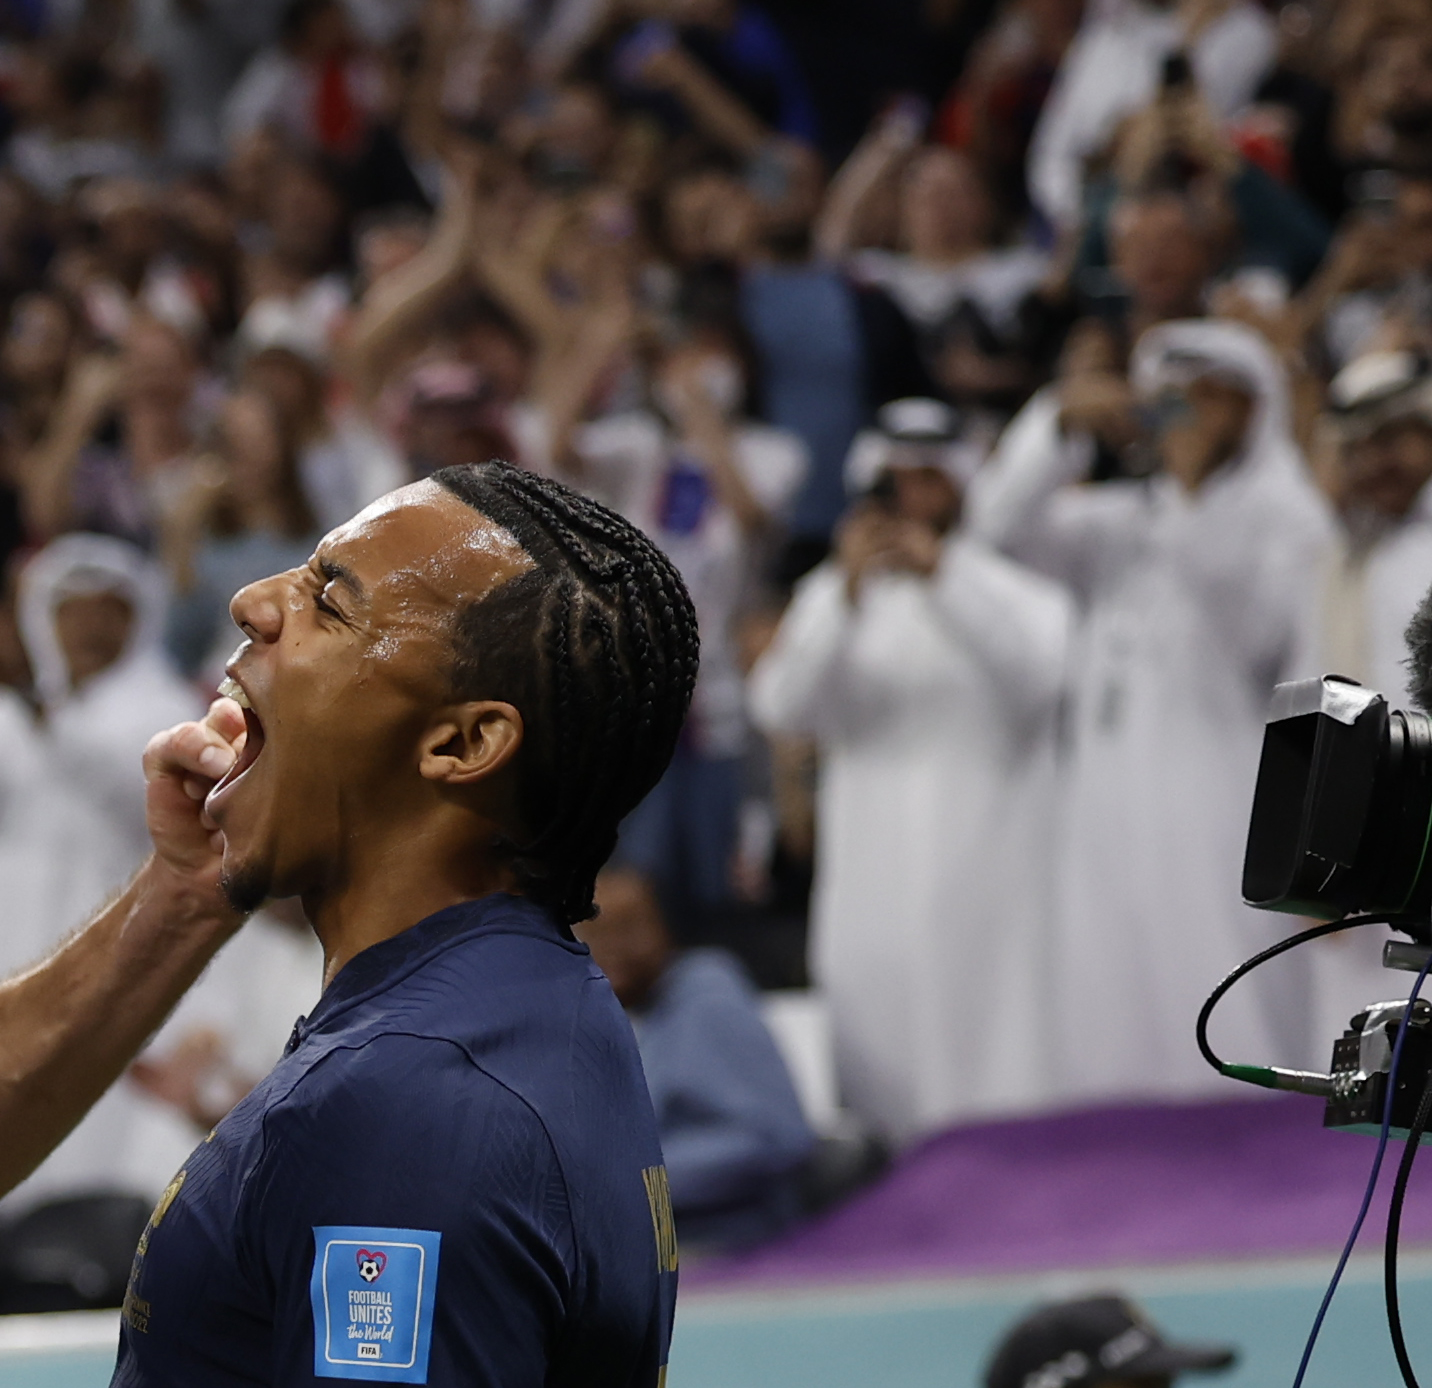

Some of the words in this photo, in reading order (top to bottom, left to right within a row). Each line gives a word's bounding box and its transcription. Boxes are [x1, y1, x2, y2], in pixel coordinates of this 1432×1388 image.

[348, 1290, 392, 1306] FOOTBALL
[349, 1304, 392, 1325] UNITES
[347, 1323, 364, 1339] the
[364, 1325, 395, 1343] World
[361, 1346, 377, 1356] FIFA
